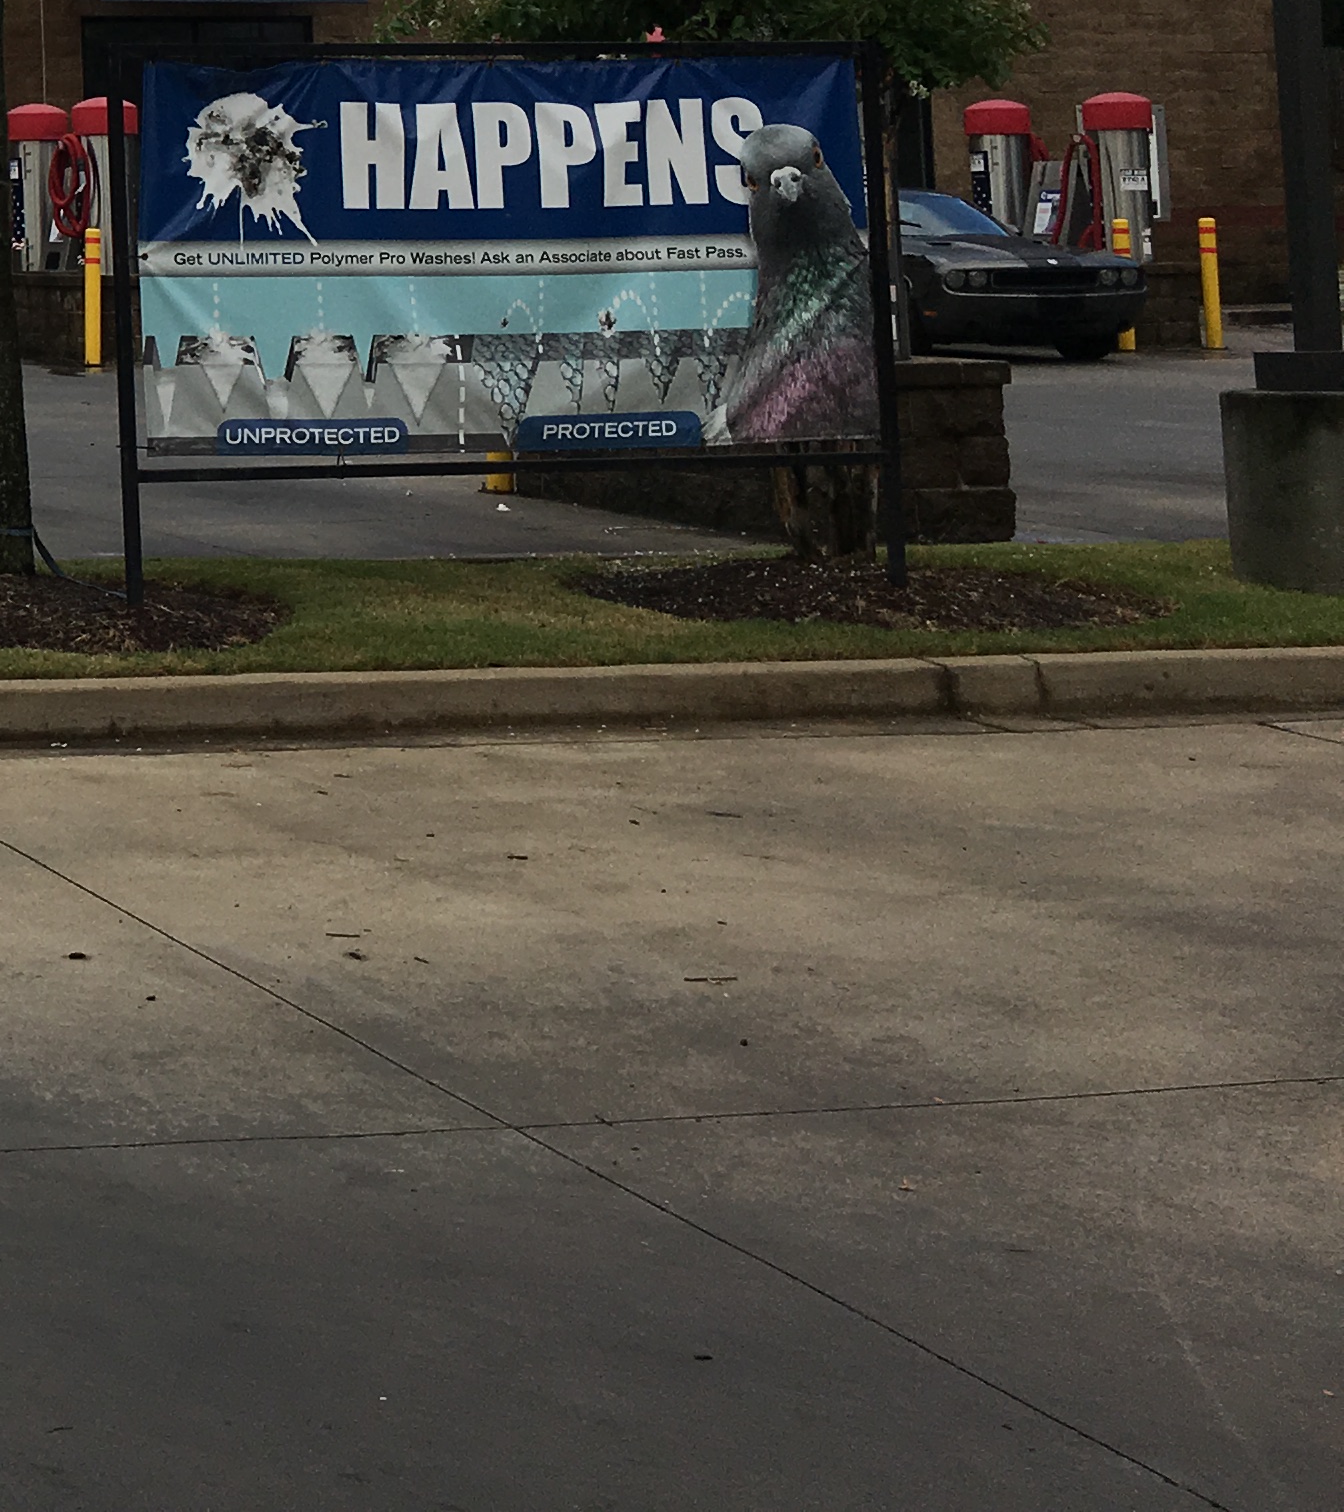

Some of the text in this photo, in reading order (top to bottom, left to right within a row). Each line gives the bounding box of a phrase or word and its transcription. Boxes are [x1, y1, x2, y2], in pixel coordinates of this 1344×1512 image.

[340, 97, 763, 209] HAPPENS
[173, 245, 747, 267] Get UNLIMITED Polymer Pro Washes! Ask an Associate about Fast Pass.
[225, 426, 400, 445] UNPROTECTED
[542, 420, 677, 440] PROTECTED
